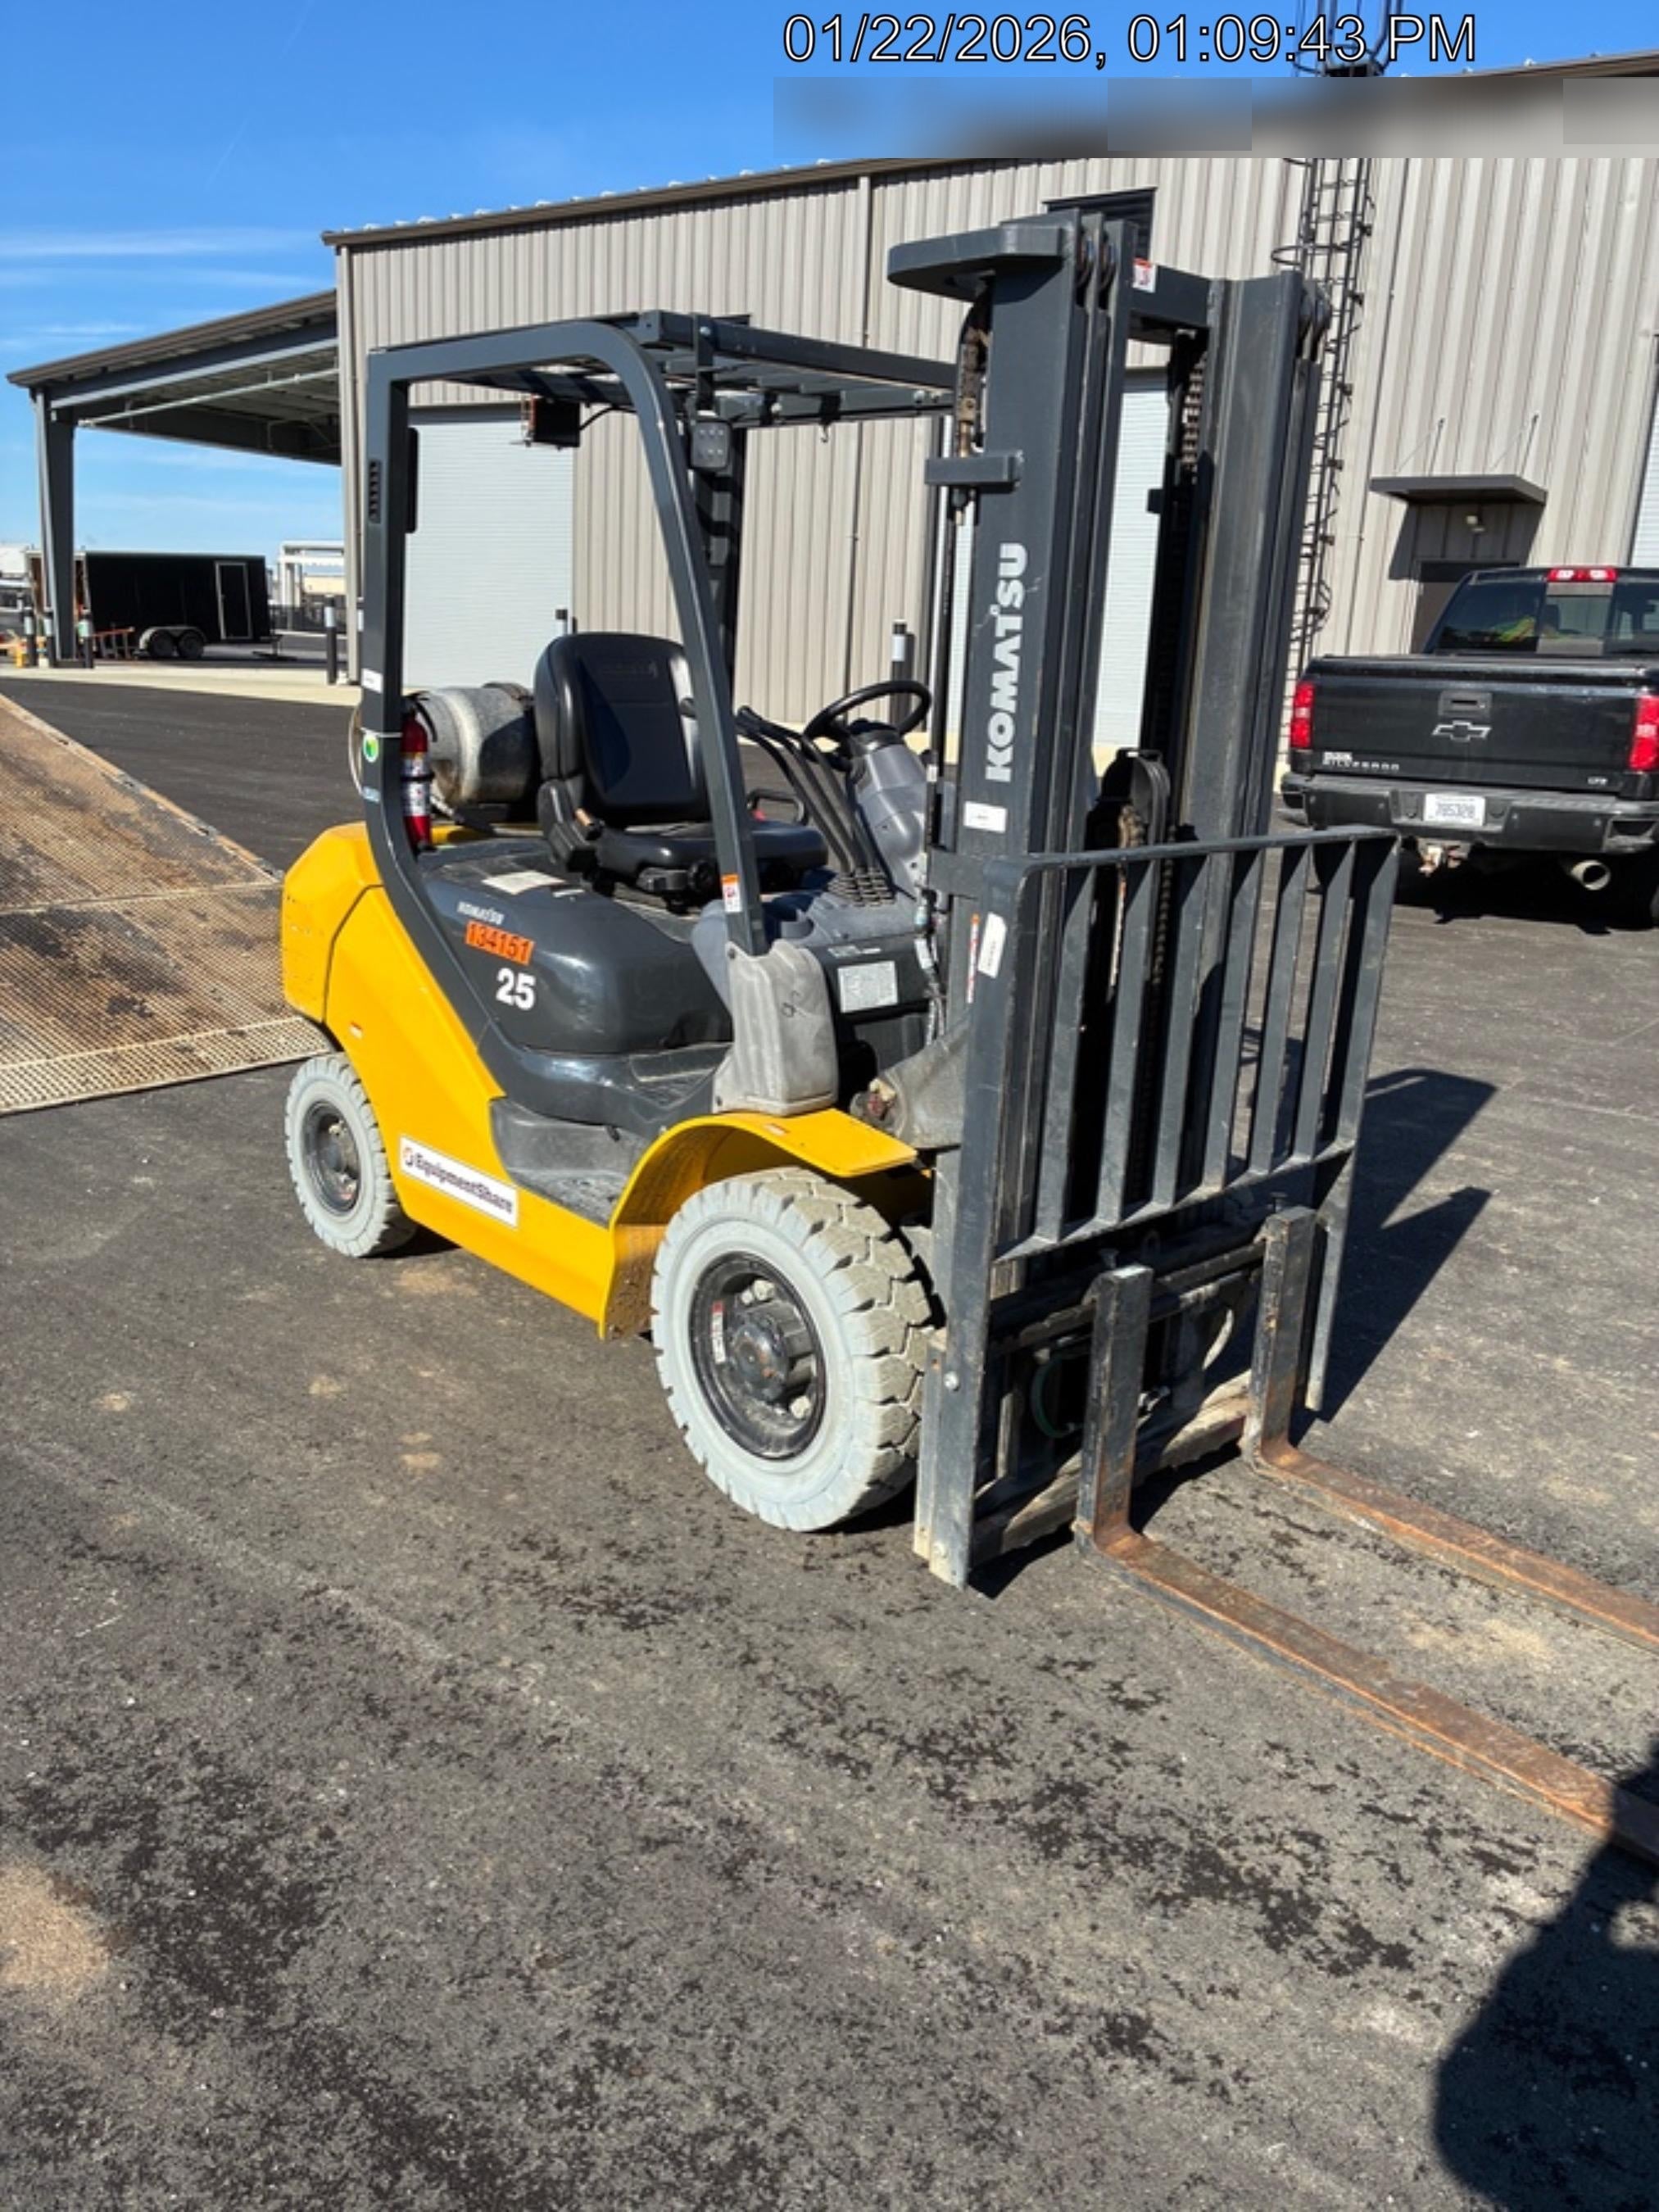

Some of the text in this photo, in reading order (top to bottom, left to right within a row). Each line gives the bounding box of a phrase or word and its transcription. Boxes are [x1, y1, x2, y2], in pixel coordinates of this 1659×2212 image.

[986, 542, 1028, 782] KOMATSU
[468, 922, 531, 962] 134151
[496, 968, 537, 1010] 25
